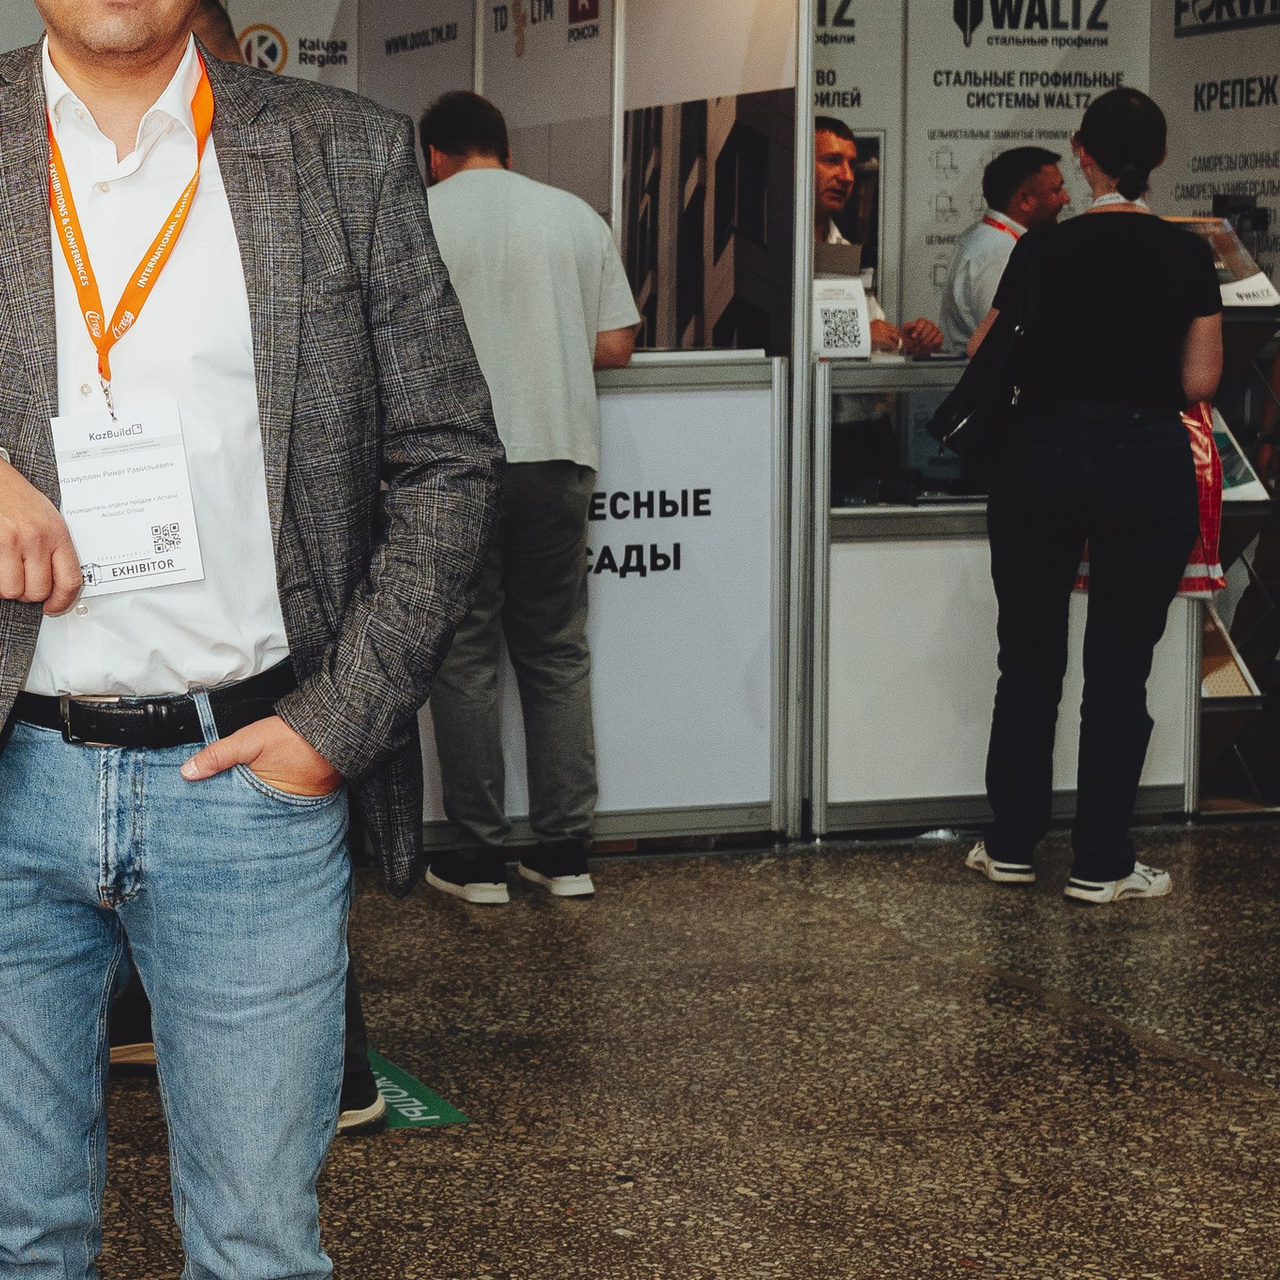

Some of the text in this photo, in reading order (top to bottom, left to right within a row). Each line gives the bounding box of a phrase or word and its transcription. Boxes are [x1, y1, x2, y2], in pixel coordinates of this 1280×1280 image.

[298, 38, 348, 53] Kaluga
[986, 35, 1109, 49] стальные профили
[298, 52, 348, 68] Region
[933, 70, 1124, 89] СТАЛЬНЫЕ ПРОФИЛЬНЫЕ
[966, 92, 1040, 110] СИСТЕМЫ
[1193, 74, 1278, 113] КРЕПЕЖ
[49, 162, 90, 287] EXHIBITIONS & CONFERENCES
[136, 219, 179, 288] INTERNATIONAL
[88, 427, 132, 441] KazBuild
[102, 469, 125, 478] Ринат
[127, 462, 175, 474] Рамильевич
[65, 505, 107, 516] Руководитель
[108, 501, 129, 510] отдела
[129, 497, 151, 507] продаж
[101, 507, 145, 519] Acoustic Group
[112, 559, 175, 577] EXHIBITOR
